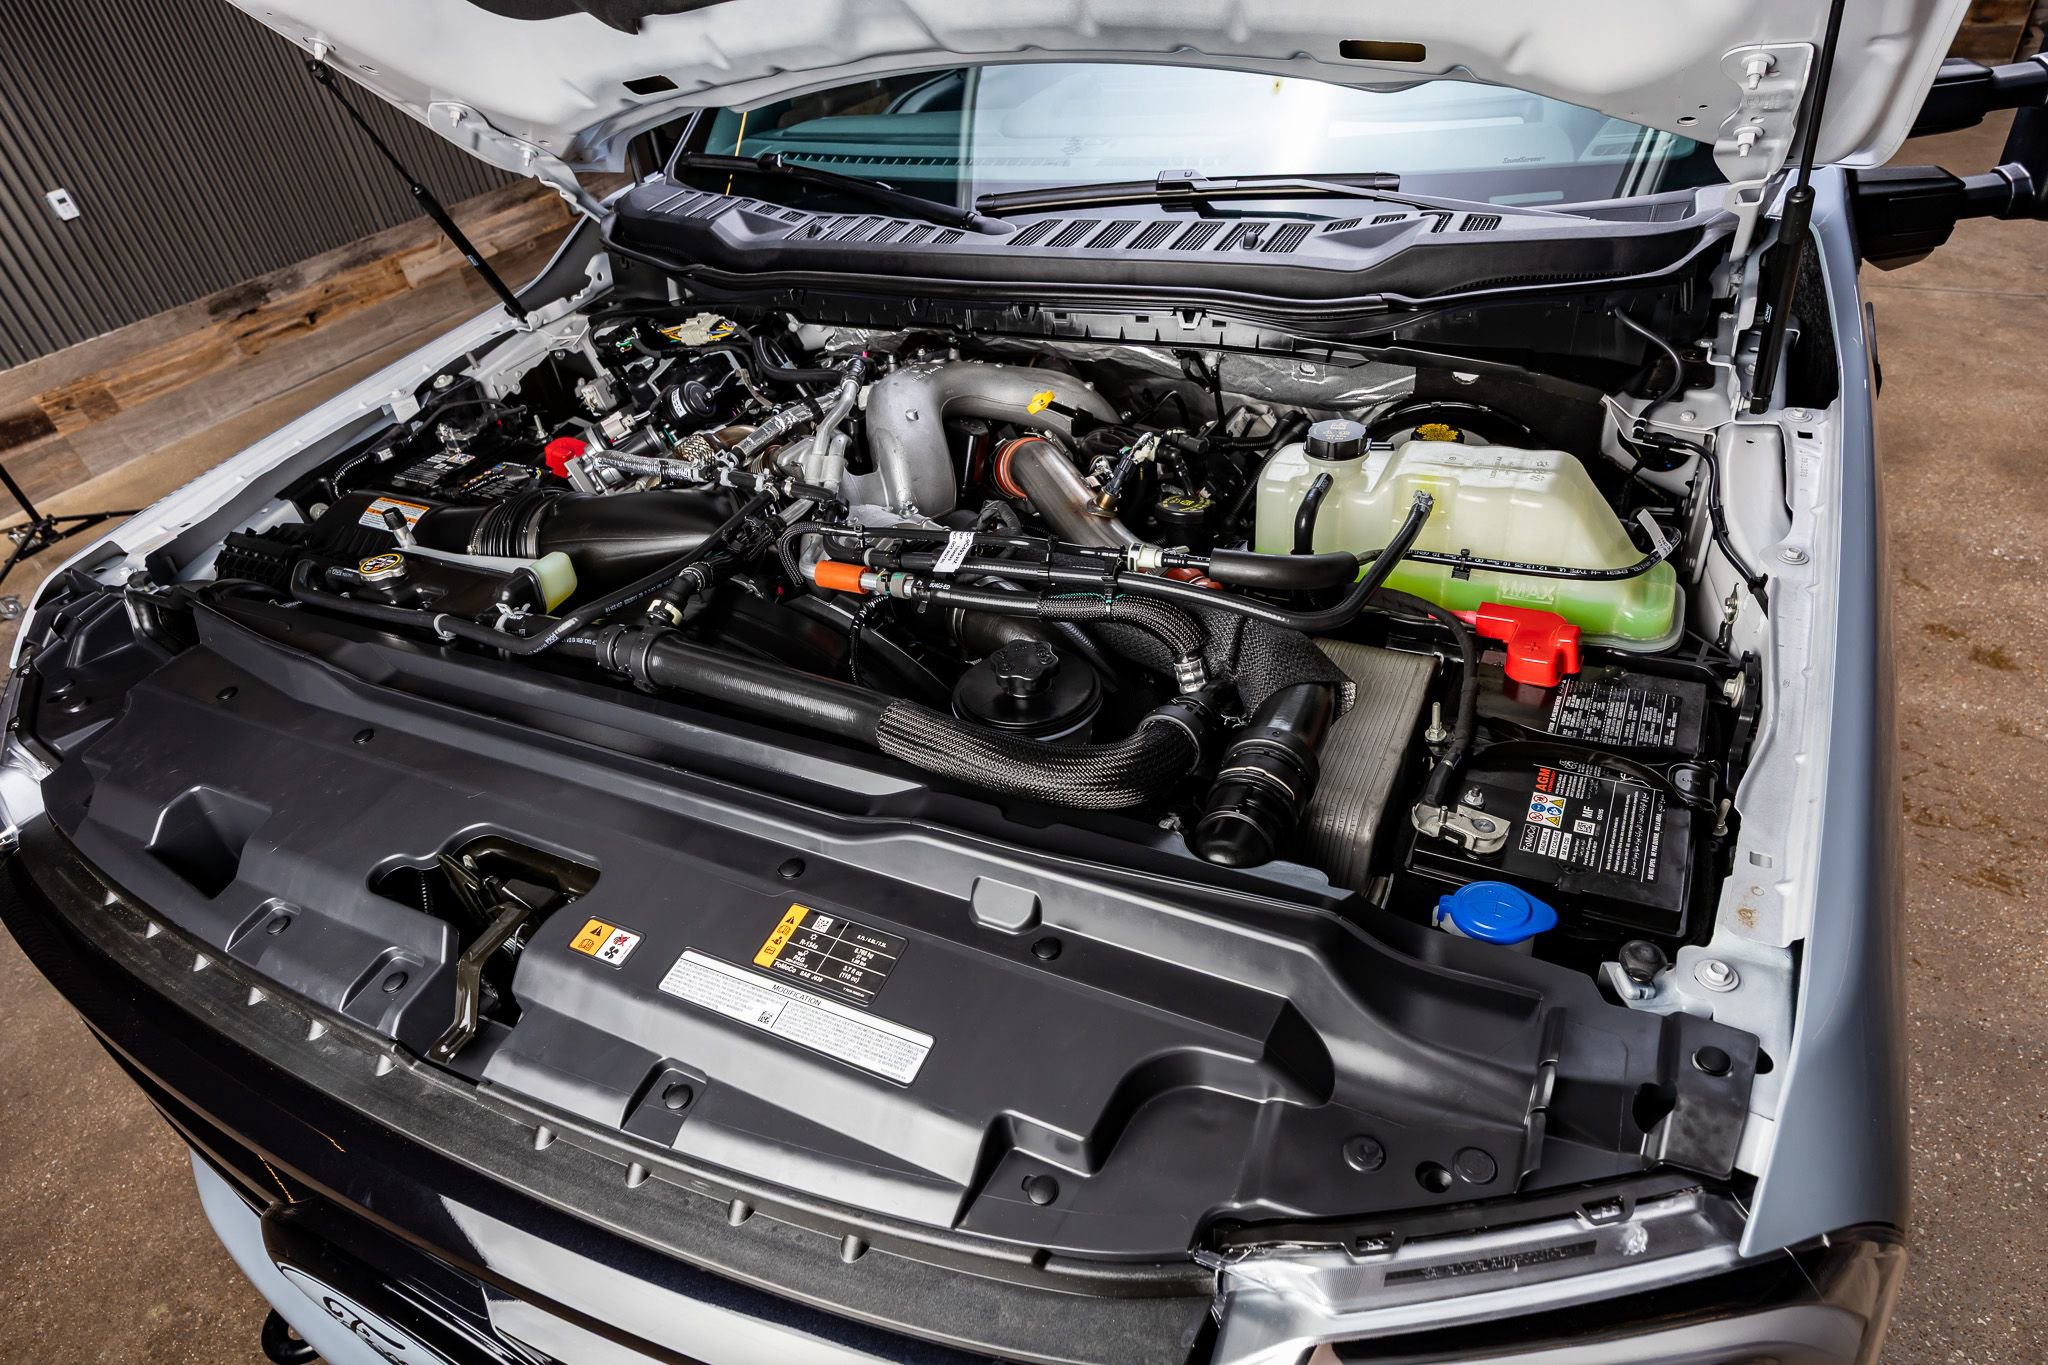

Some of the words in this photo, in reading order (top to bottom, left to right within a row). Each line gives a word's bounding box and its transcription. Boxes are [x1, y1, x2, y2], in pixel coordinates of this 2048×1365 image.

[1535, 767, 1551, 792] AGM
[1523, 825, 1536, 850] FoMoCo
[799, 938, 819, 949] R-134a
[773, 960, 797, 974] FoMoCo
[792, 954, 806, 963] PAG
[771, 984, 822, 1007] MODIFICATION
